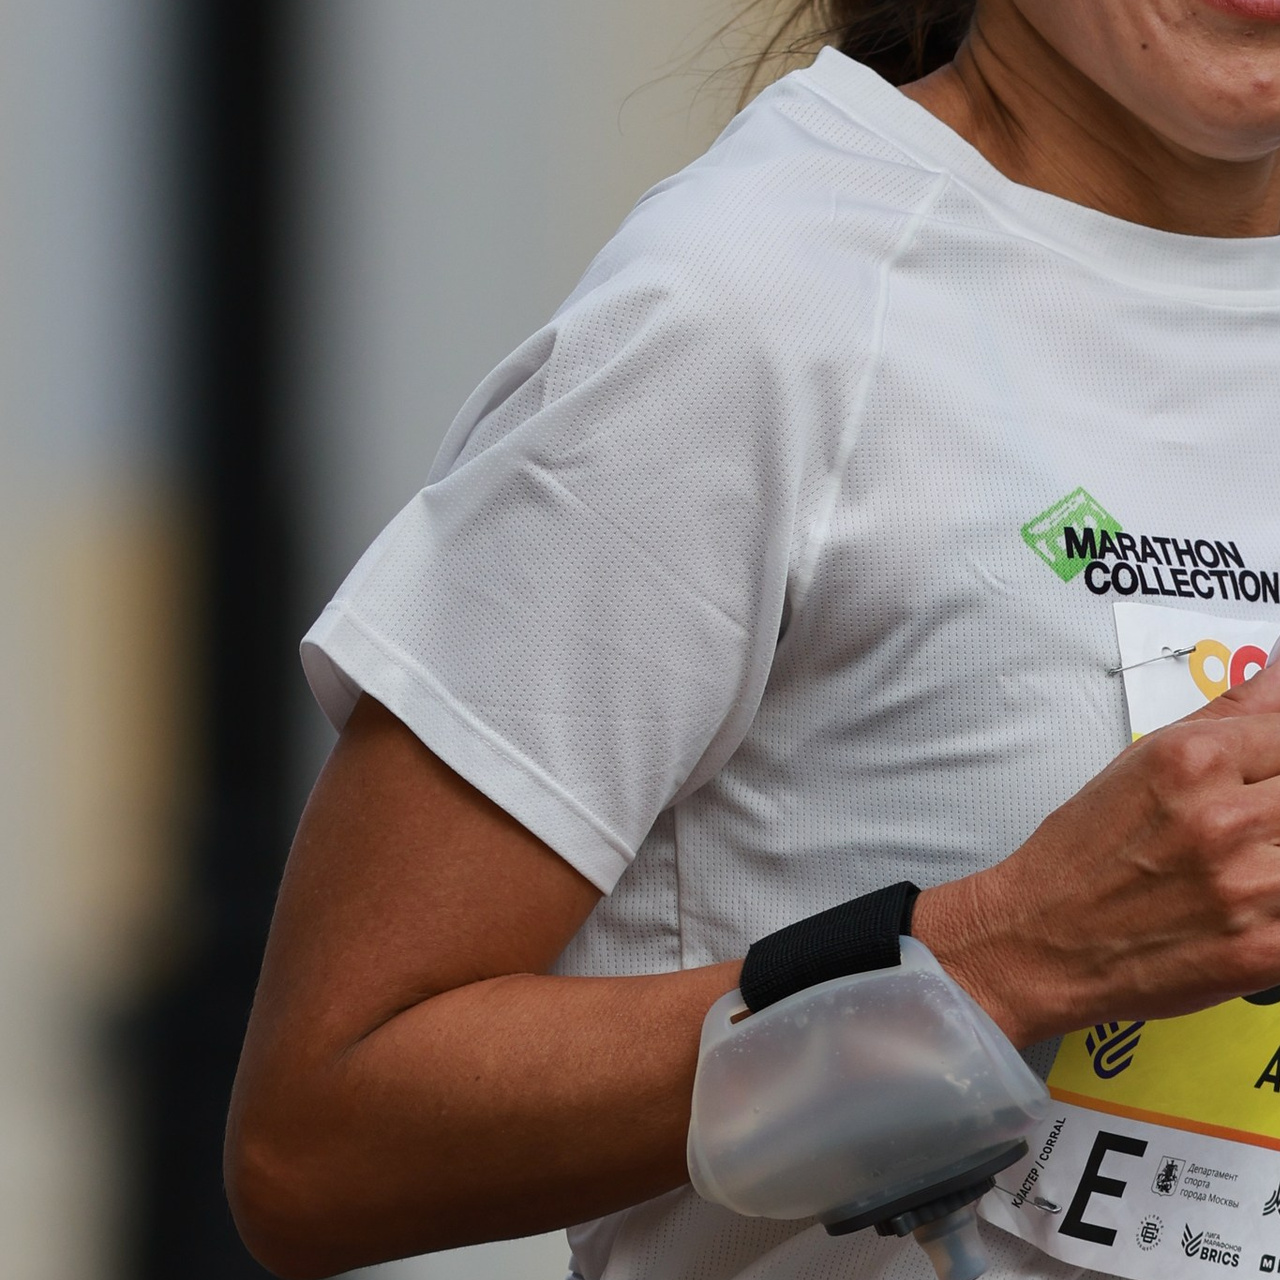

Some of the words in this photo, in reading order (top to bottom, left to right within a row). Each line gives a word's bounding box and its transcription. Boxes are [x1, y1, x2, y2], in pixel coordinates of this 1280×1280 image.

[1063, 526, 1245, 568] MARATHON
[1084, 560, 1280, 604] COLLECTION
[1011, 1166, 1039, 1209] КЛАСТЕР
[1039, 1116, 1067, 1162] CORRAL
[1187, 1163, 1239, 1182] Департамент
[1183, 1177, 1211, 1191] спорта
[1179, 1188, 1208, 1204] города
[1208, 1193, 1240, 1209] Москвы
[1200, 1246, 1240, 1267] BRICS
